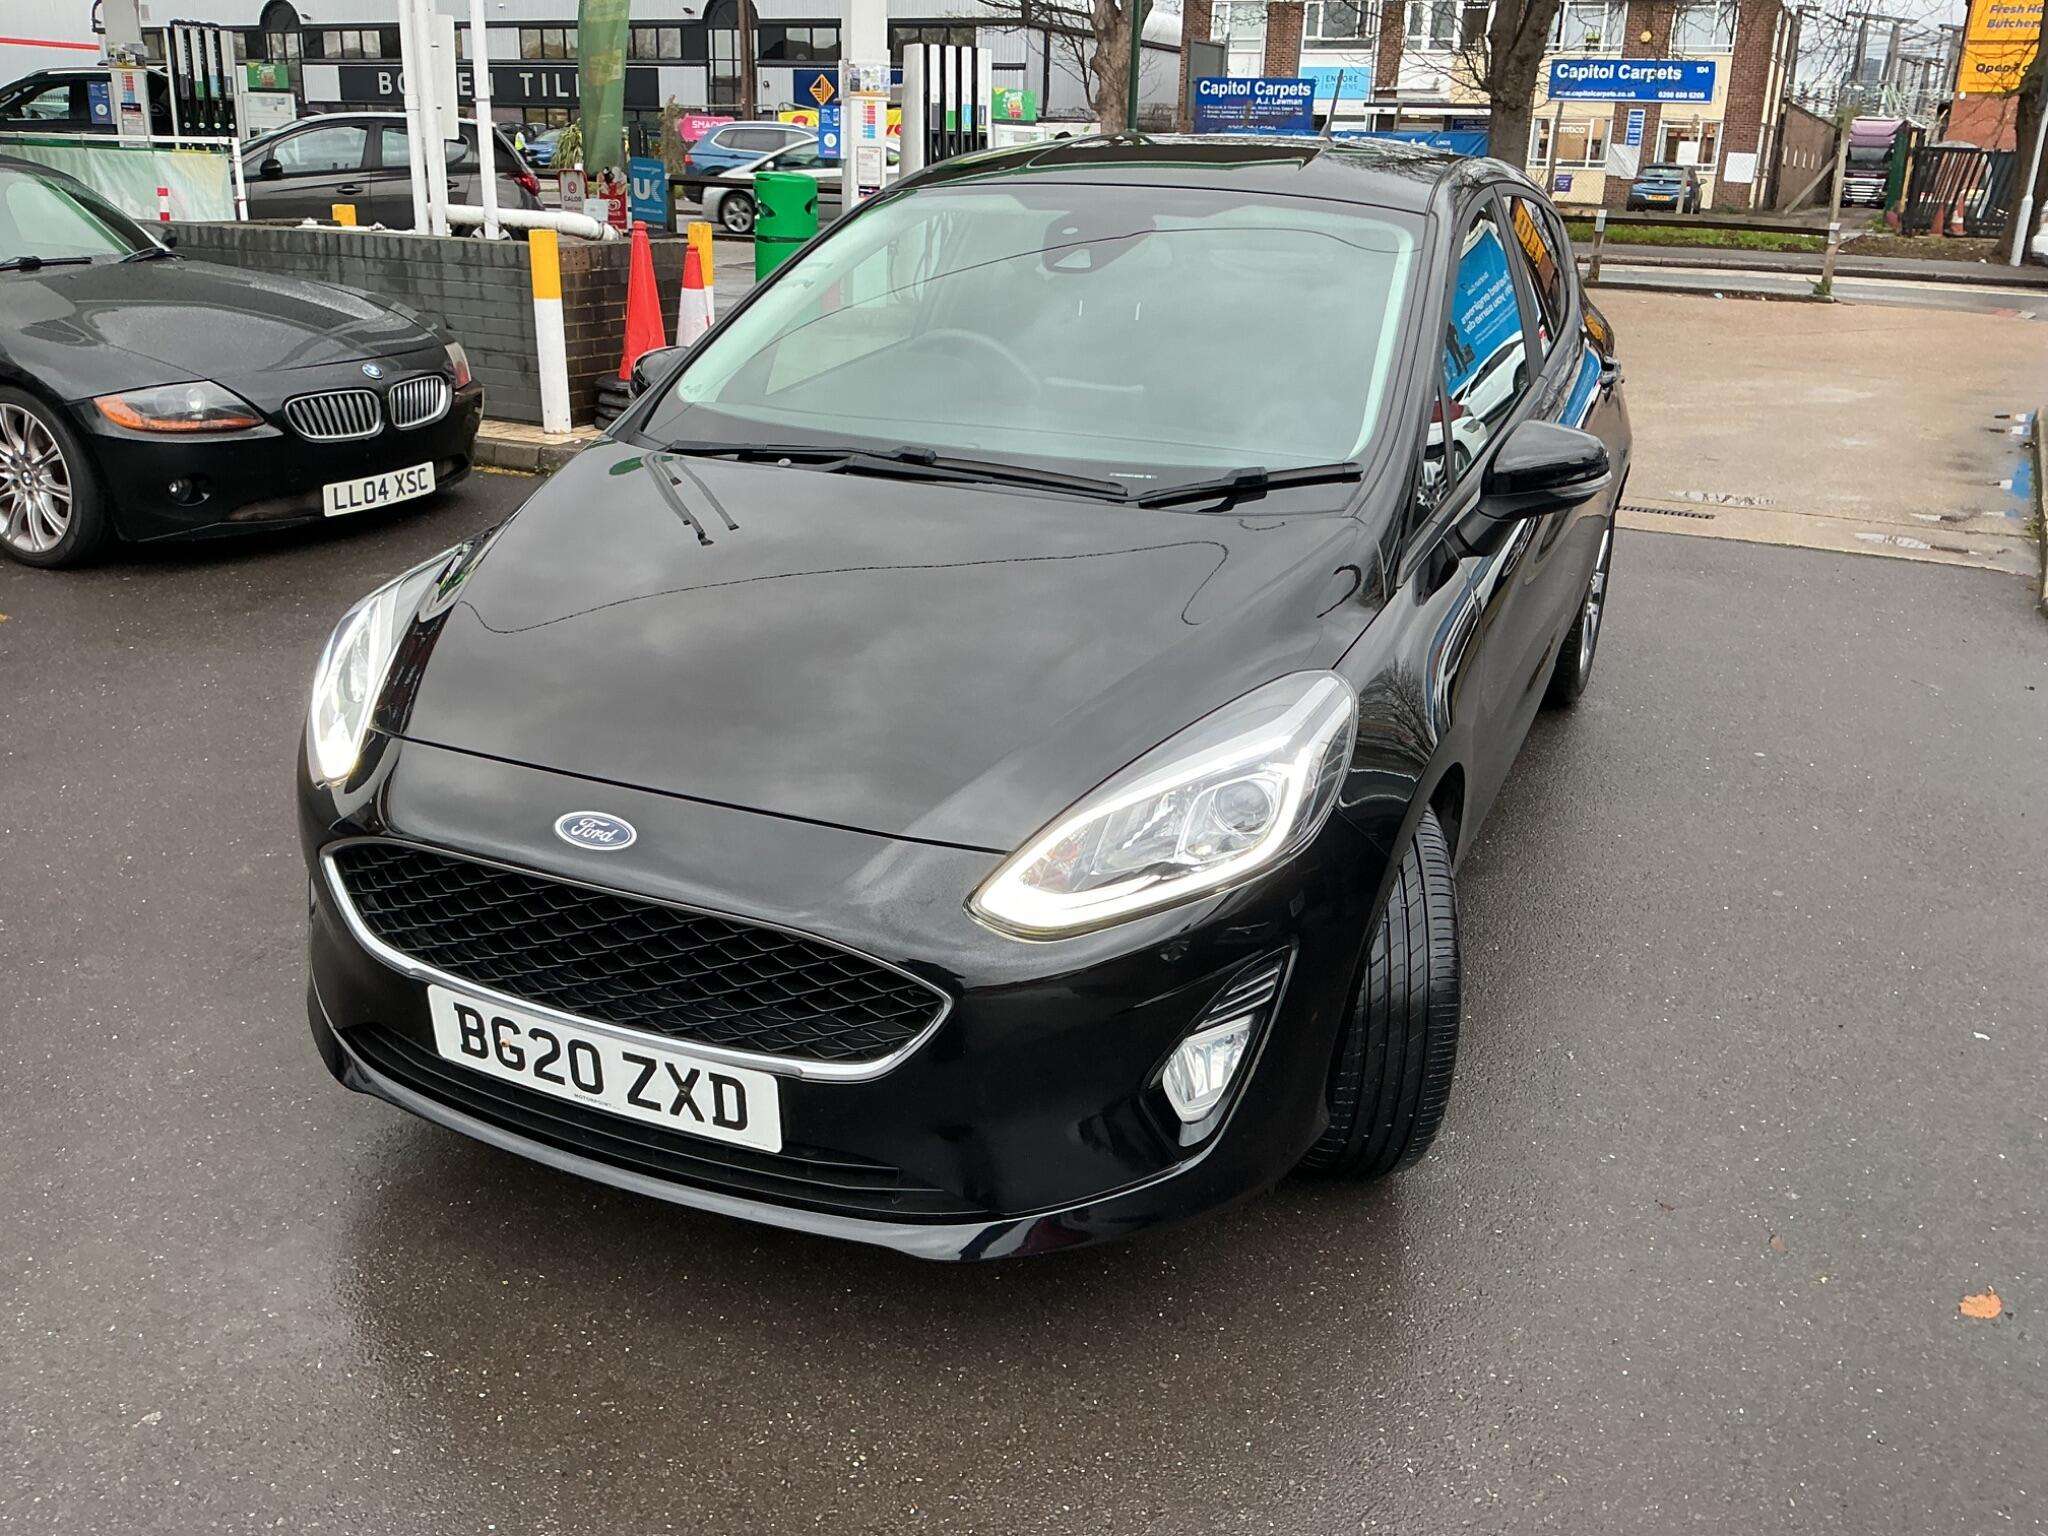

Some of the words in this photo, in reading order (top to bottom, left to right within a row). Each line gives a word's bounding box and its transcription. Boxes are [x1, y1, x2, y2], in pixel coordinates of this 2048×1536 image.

[1990, 4, 2024, 13] Fresh
[1556, 63, 1614, 81] Capitol
[1618, 65, 1682, 82] Carpets
[1200, 80, 1250, 97] Capitol
[1254, 81, 1312, 98] Carpets
[333, 478, 390, 511] LL04
[394, 467, 429, 498] XSC
[570, 818, 620, 842] Ford
[452, 1001, 605, 1096] BG20
[621, 1051, 749, 1132] ZXD
